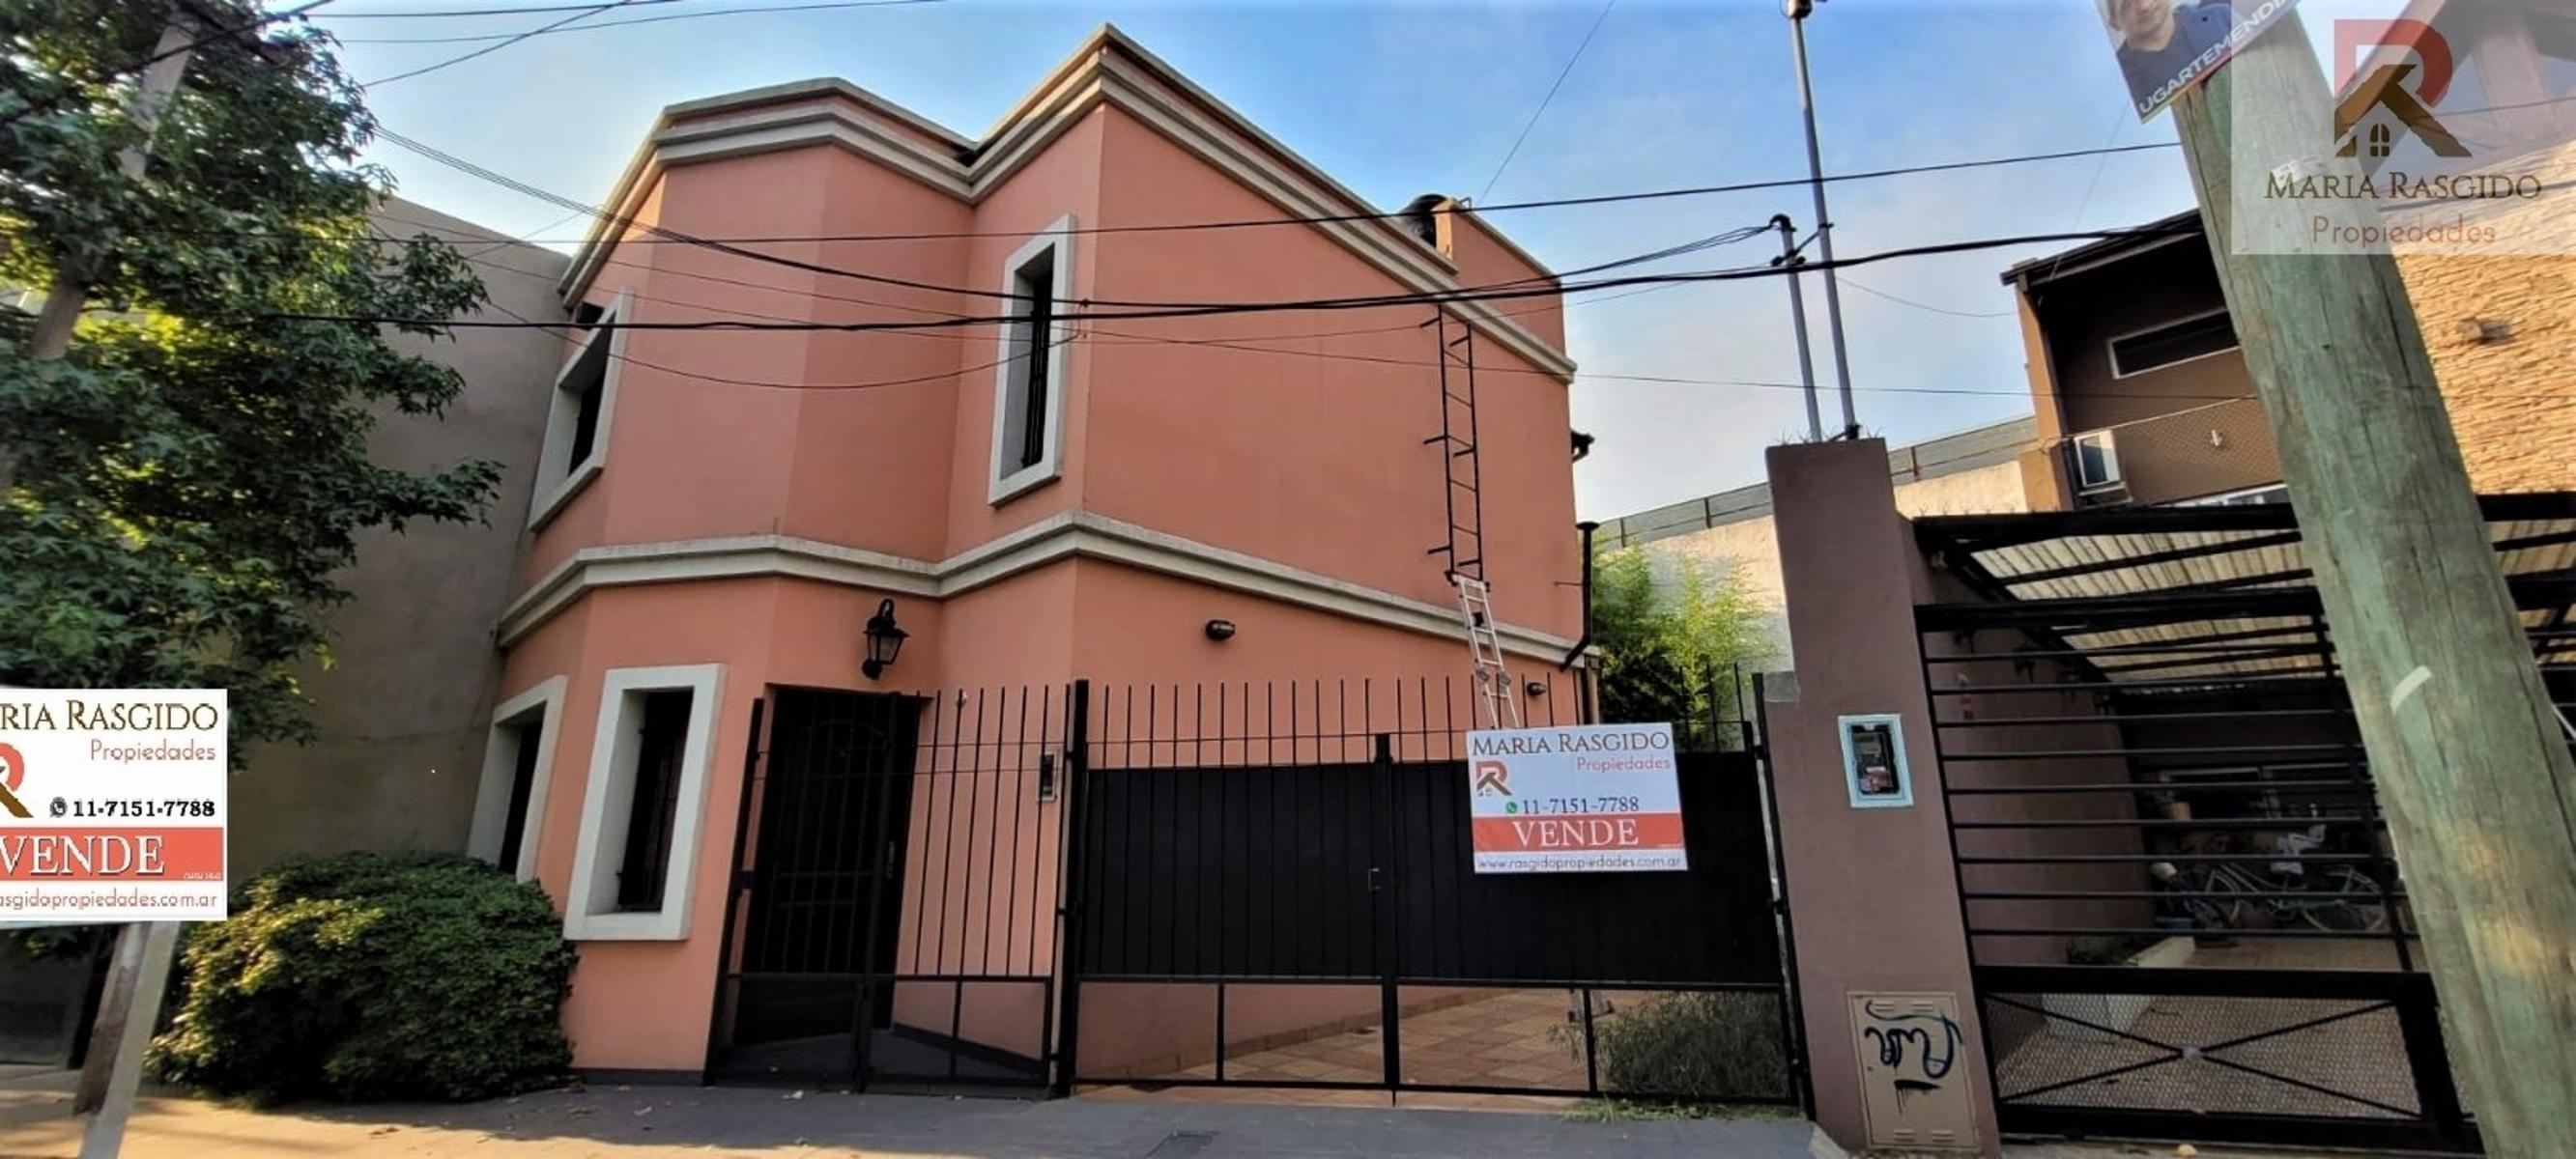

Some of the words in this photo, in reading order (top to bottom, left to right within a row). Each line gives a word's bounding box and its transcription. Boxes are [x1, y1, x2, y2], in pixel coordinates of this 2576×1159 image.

[2138, 0, 2286, 114] UGARTEMENDI
[67, 699, 219, 731] RASGIDO
[91, 739, 216, 764] Propiedades
[1473, 736, 1551, 756] MARIA
[1559, 731, 1670, 752] RASGIDO
[1577, 756, 1671, 773] Propiedades
[72, 799, 215, 817] 11-7151-7788
[1523, 797, 1640, 814] 11-7151-7788
[1513, 819, 1640, 848] VENDE
[0, 835, 165, 876] VENDE
